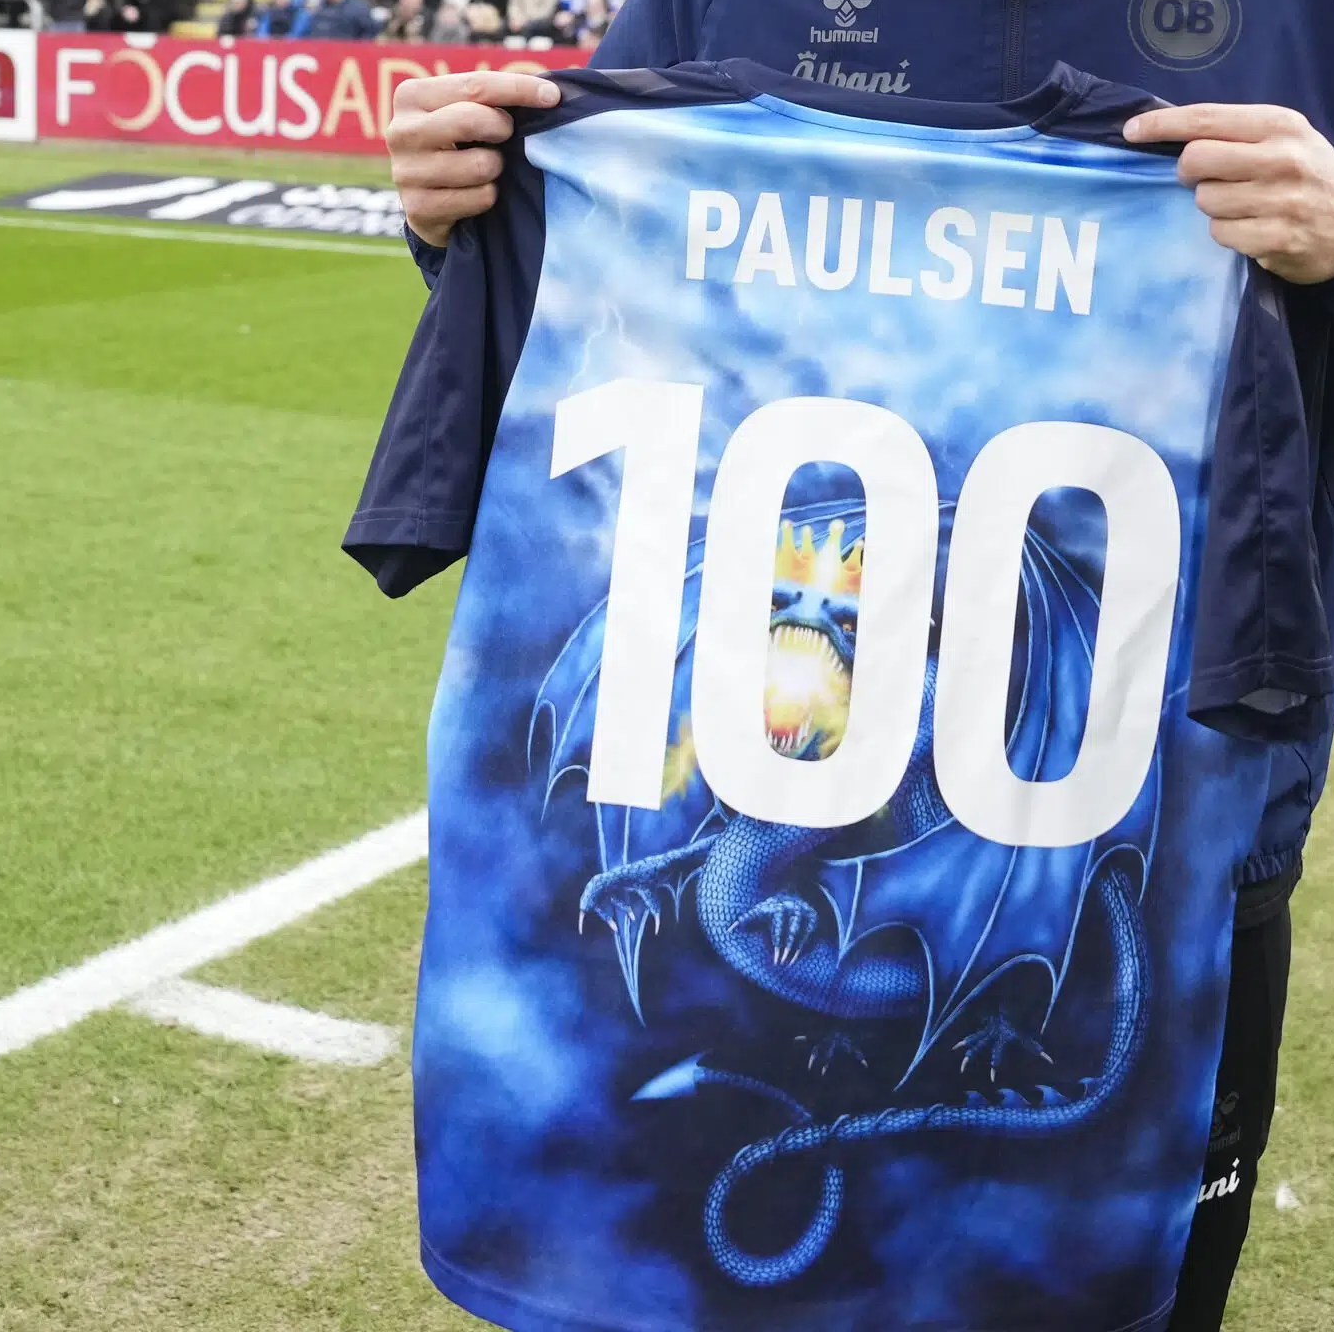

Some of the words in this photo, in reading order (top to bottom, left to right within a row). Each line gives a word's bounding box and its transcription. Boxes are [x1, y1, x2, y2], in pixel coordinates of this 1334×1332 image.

[810, 26, 879, 44] hummel
[684, 189, 1101, 317] PAULSEN
[549, 376, 1182, 848] 100
